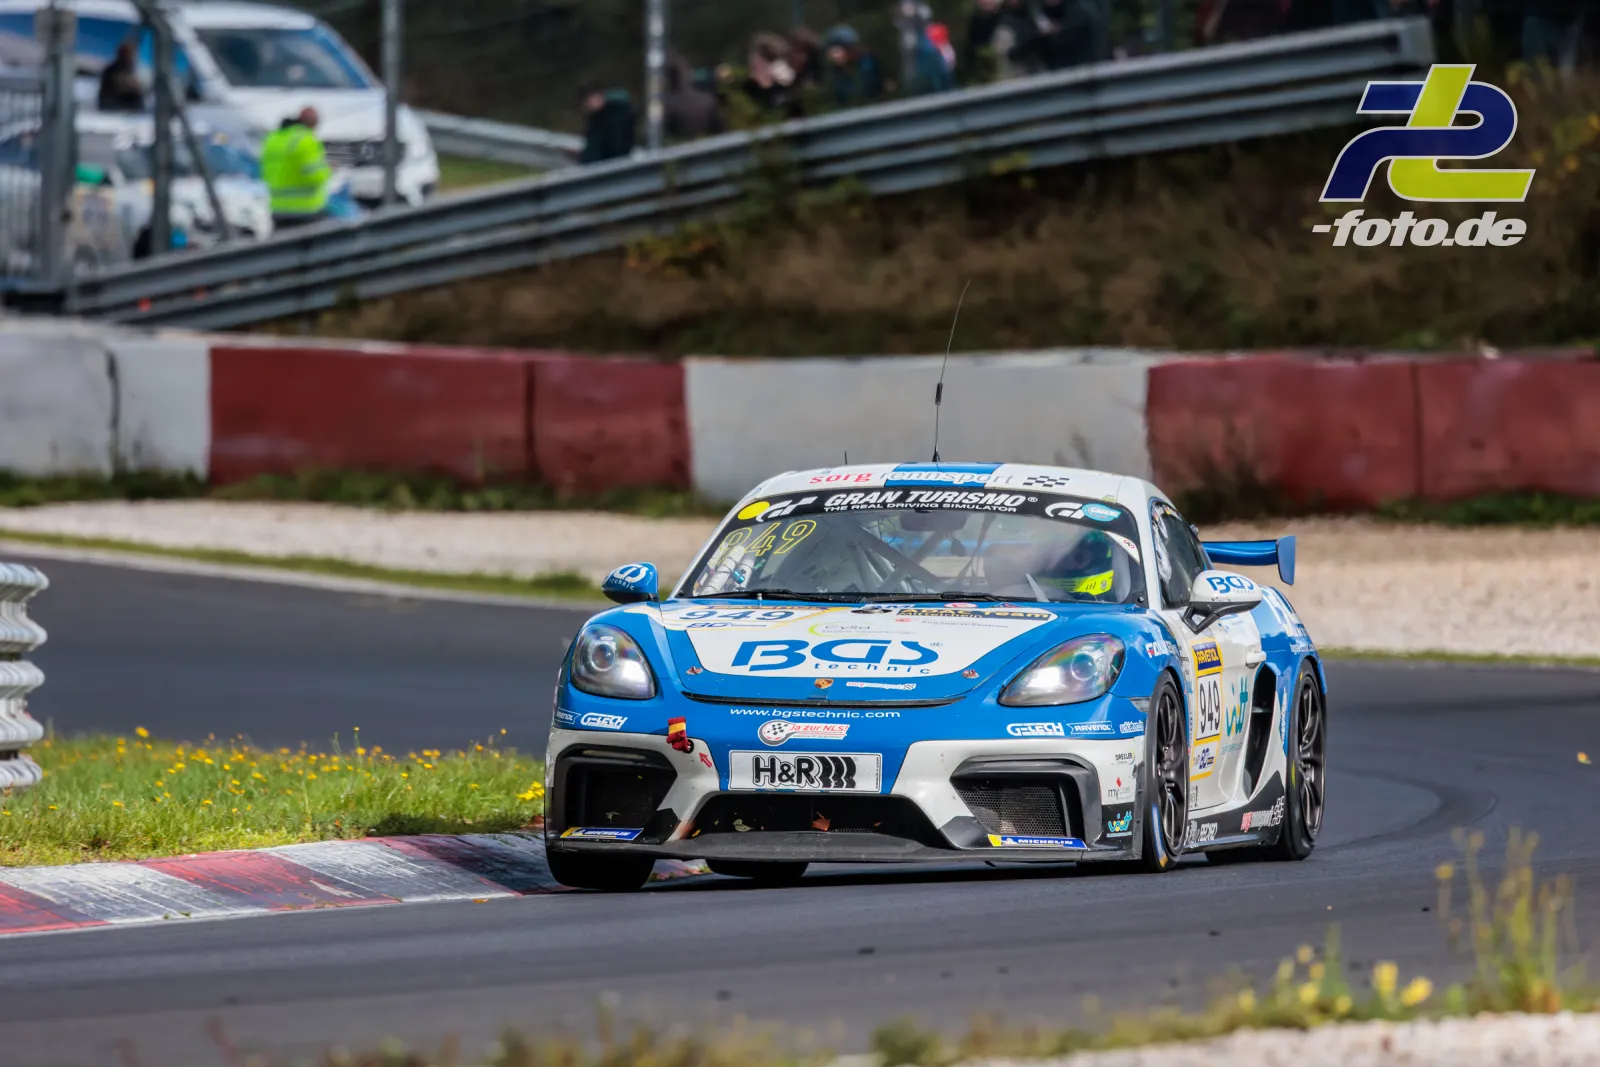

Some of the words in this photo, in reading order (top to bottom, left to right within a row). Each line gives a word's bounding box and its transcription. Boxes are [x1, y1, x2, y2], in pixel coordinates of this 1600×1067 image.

[808, 473, 873, 485] sorg
[880, 471, 1014, 485] rennsport
[824, 490, 903, 506] GRAN
[905, 490, 1027, 507] TURISMO
[942, 503, 1017, 513] SIMULATOR
[1206, 575, 1255, 594] BGS
[679, 610, 795, 621] 949
[731, 639, 939, 672] BGS
[813, 662, 931, 675] technic
[730, 708, 901, 719] www.bgstechnic.com
[1199, 680, 1221, 734] 949
[821, 724, 849, 733] NLS!
[753, 755, 820, 787] H&R
